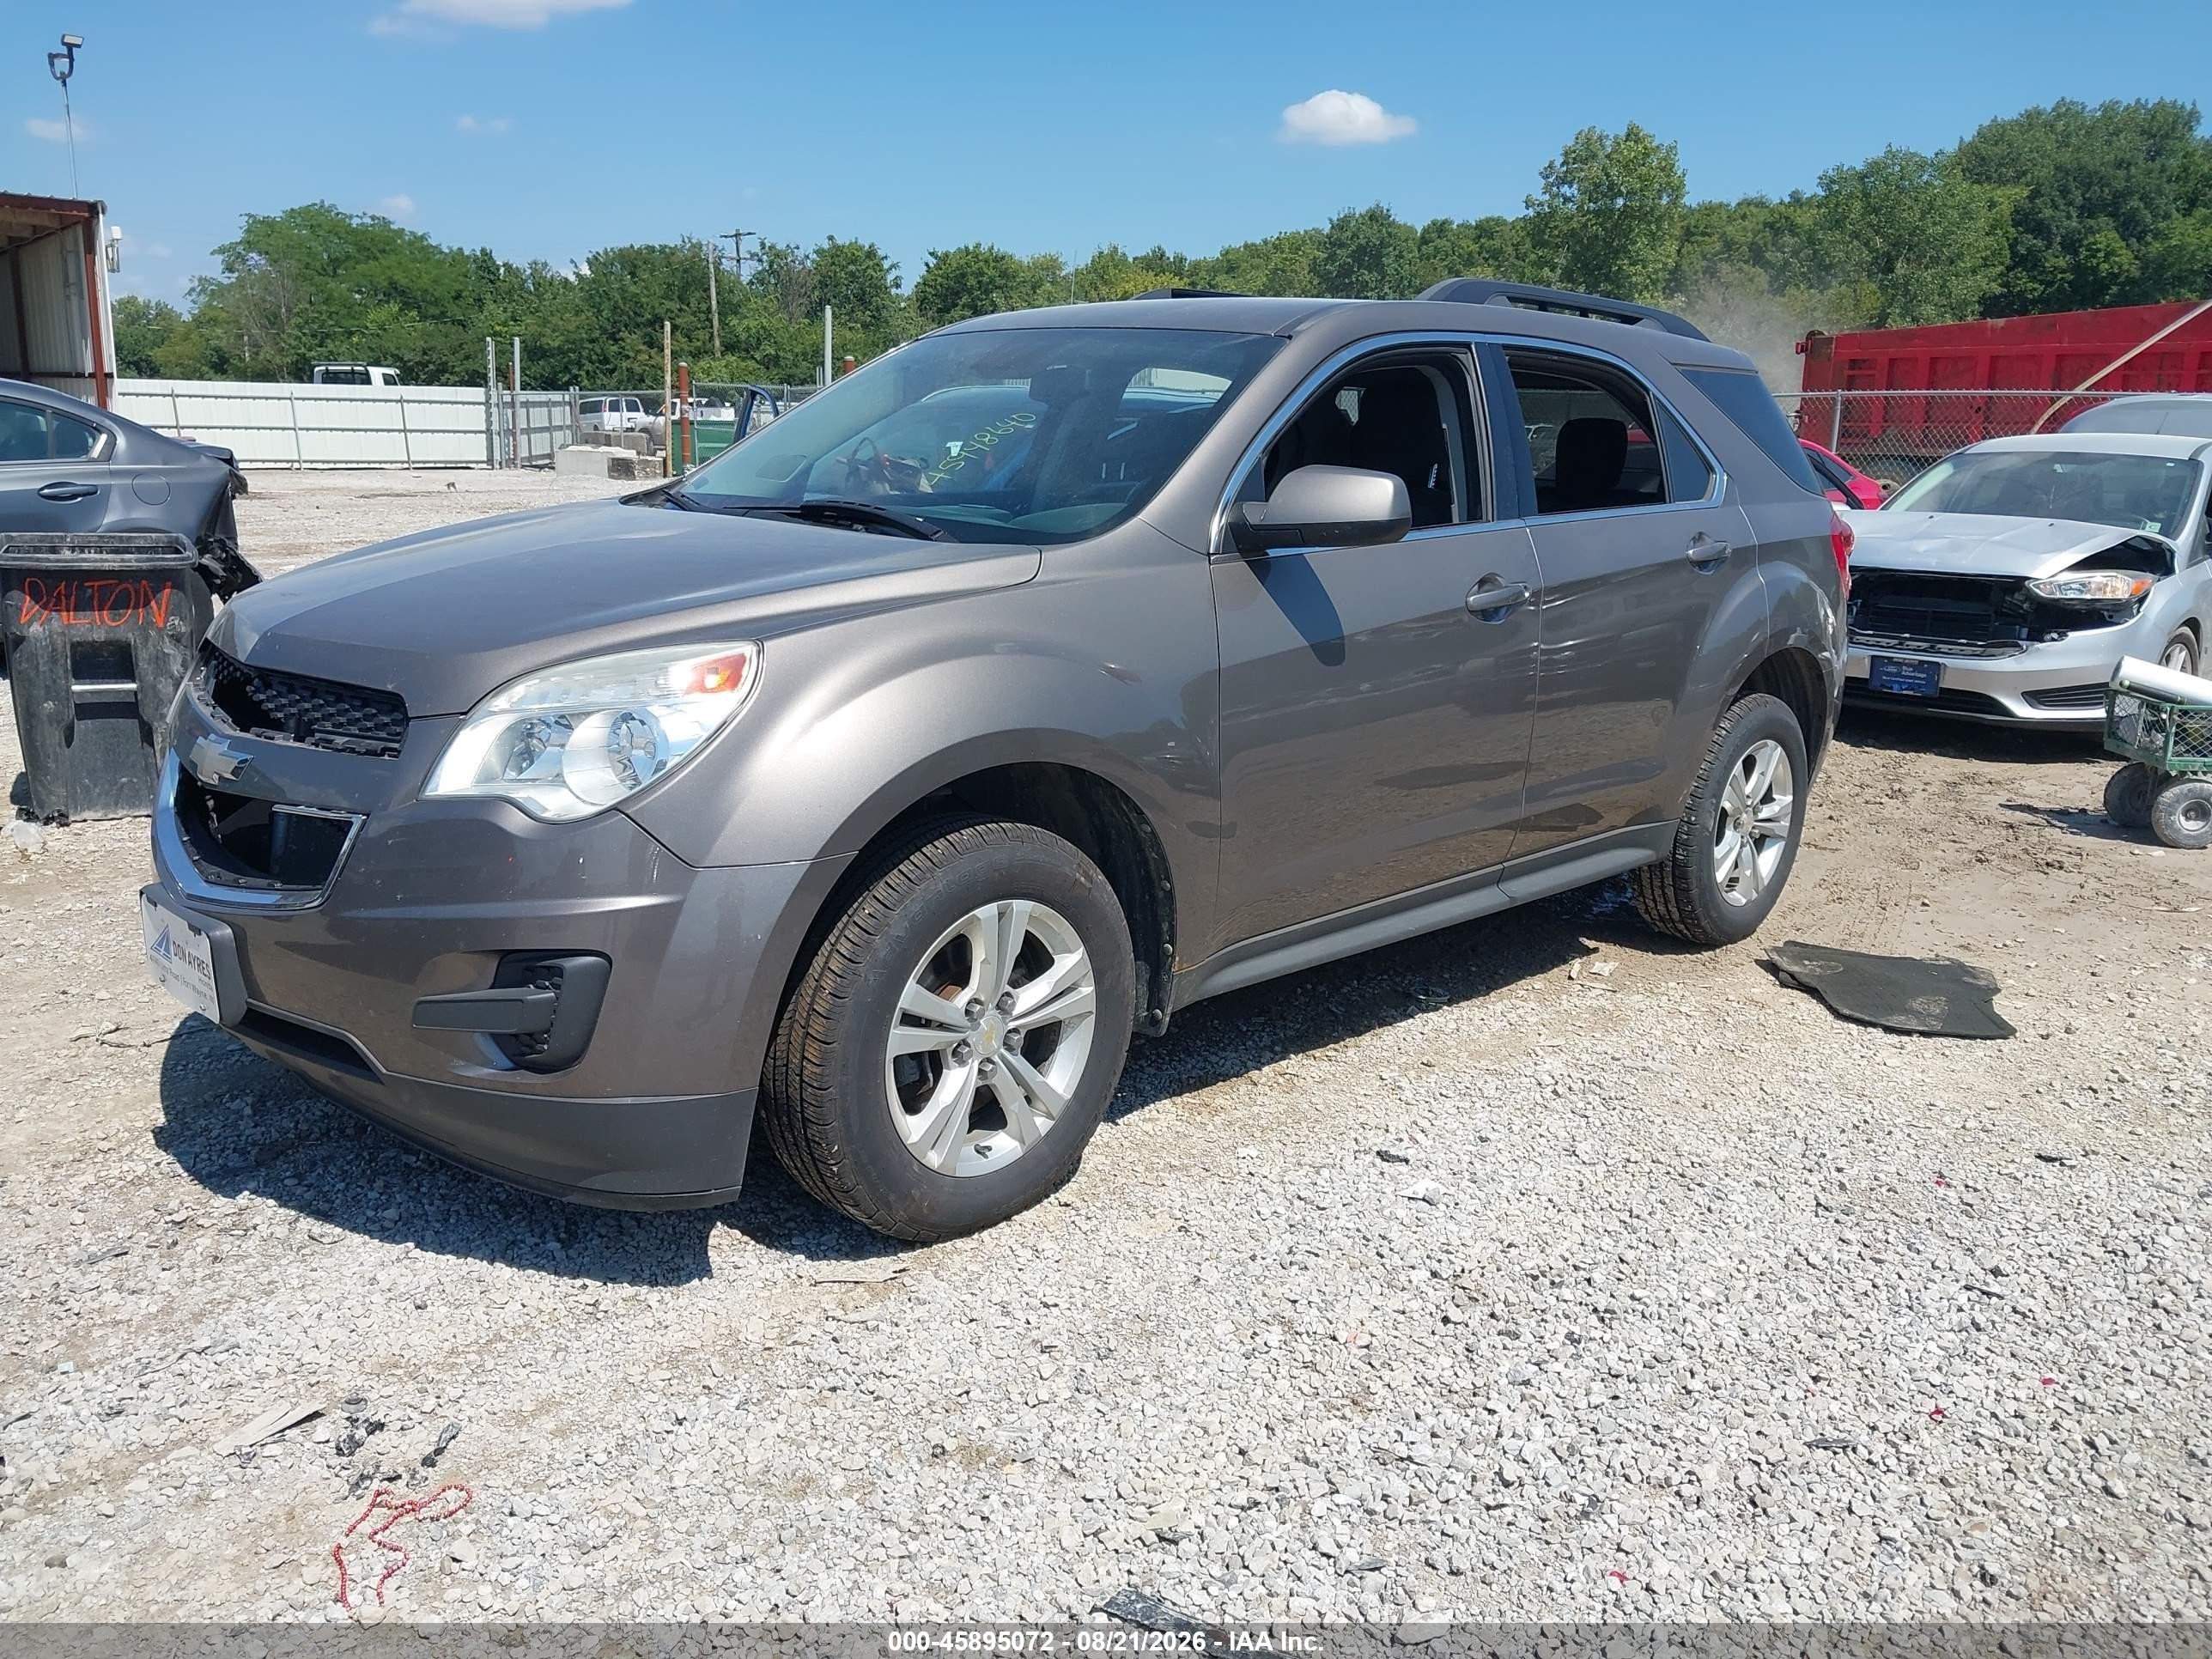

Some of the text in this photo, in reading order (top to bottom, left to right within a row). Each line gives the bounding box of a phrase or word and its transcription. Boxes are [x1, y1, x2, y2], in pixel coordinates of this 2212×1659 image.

[20, 577, 172, 629] DALTON
[173, 940, 187, 964] DON
[187, 951, 211, 981] AYRES
